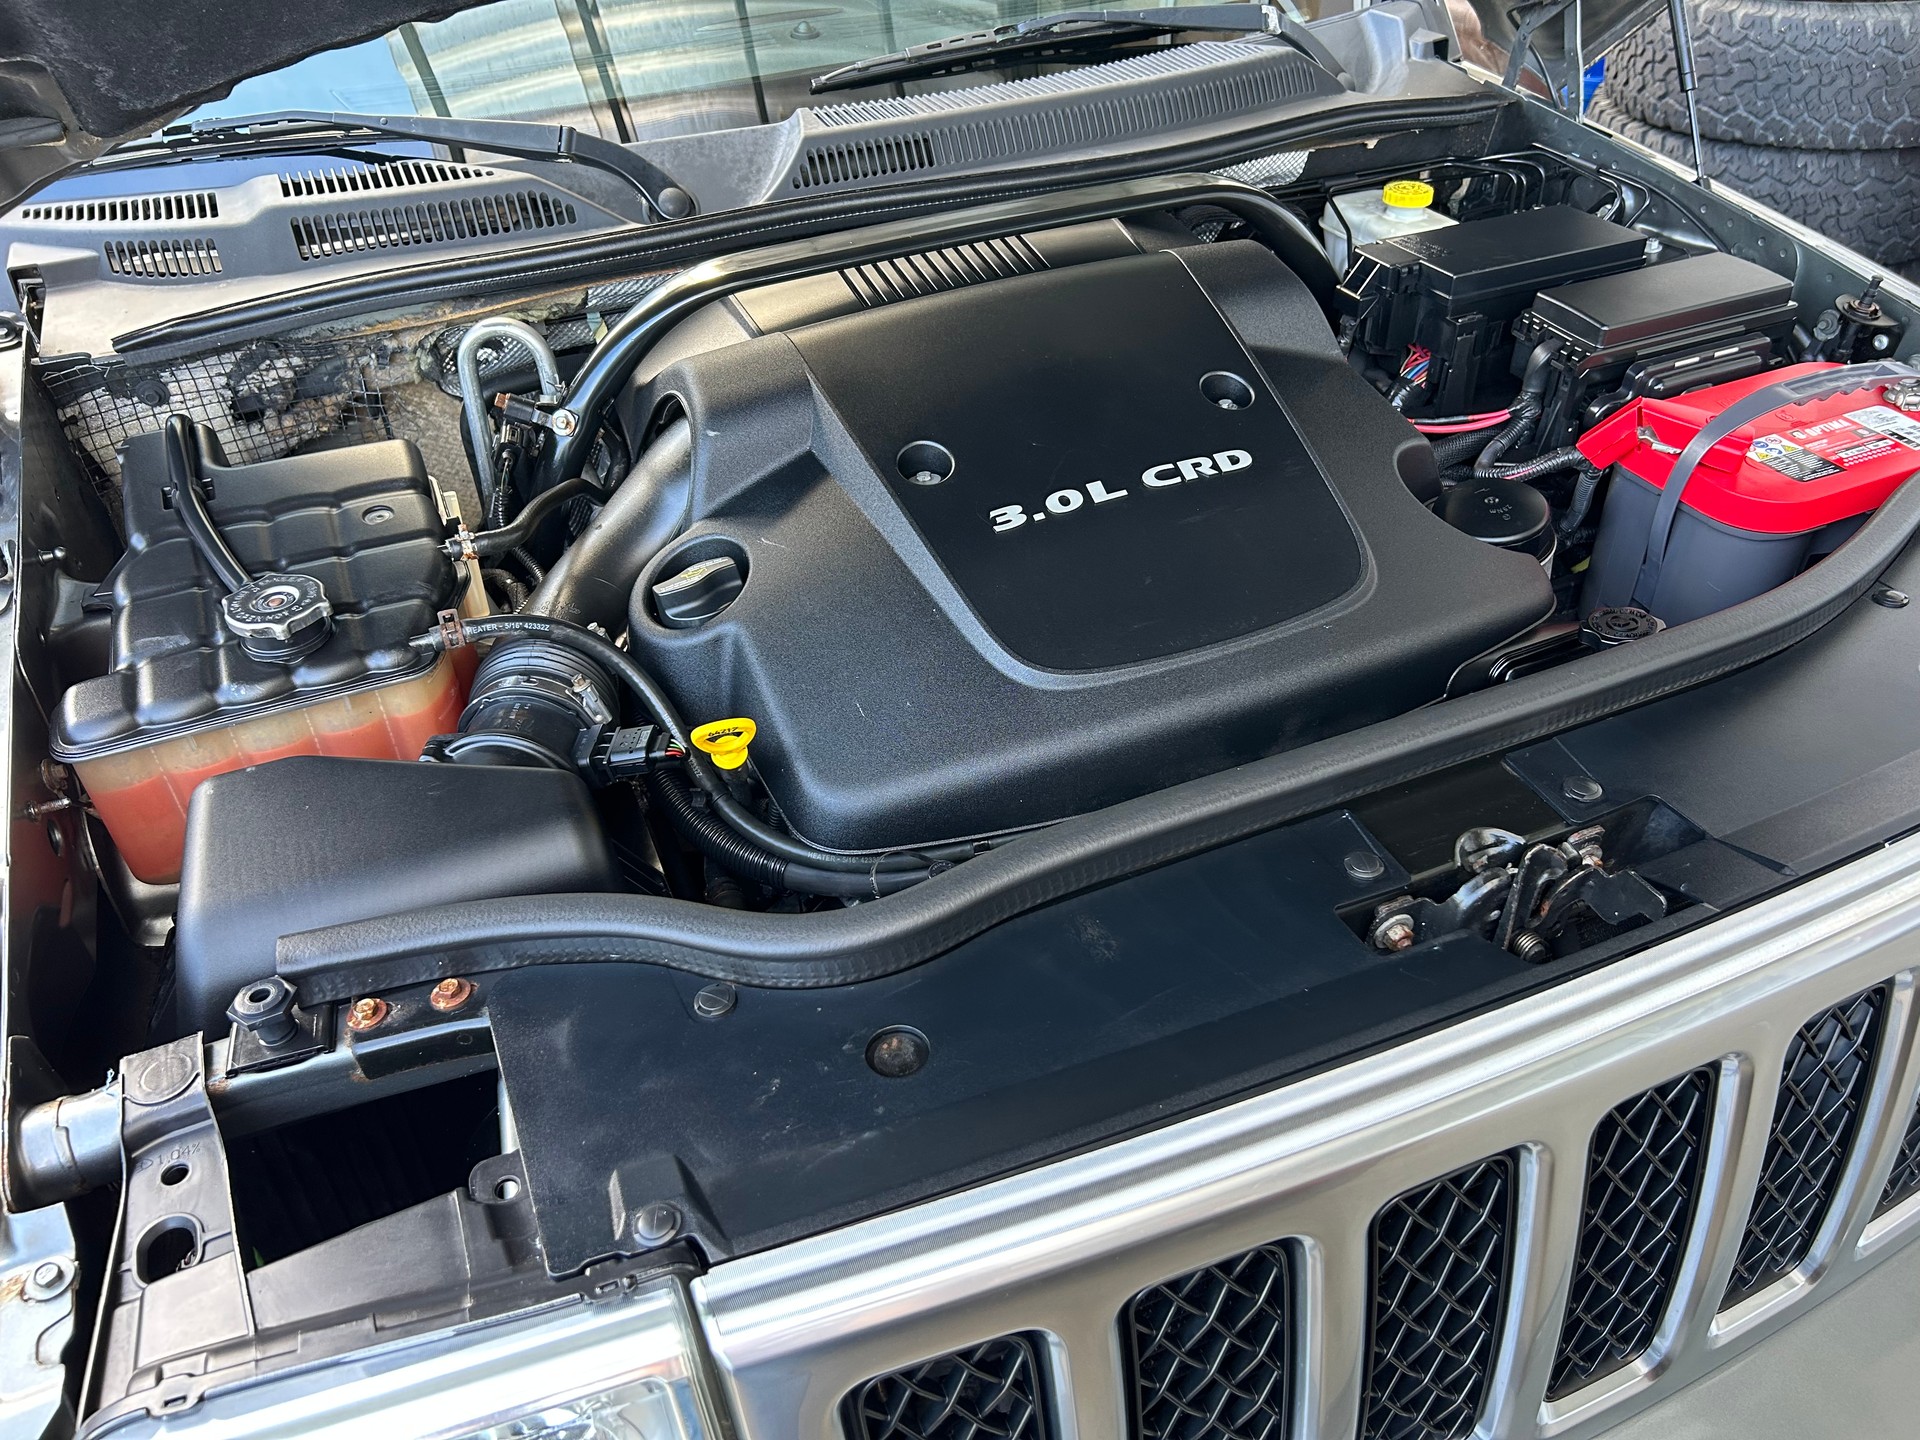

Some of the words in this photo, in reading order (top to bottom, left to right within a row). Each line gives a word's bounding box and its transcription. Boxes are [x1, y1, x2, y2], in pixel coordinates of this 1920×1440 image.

[1804, 418, 1852, 437] OPTIMA
[989, 480, 1128, 533] 3.0L
[1141, 449, 1253, 487] CRD
[466, 624, 498, 635] HEATER
[523, 623, 550, 632] 42332Z
[807, 852, 837, 863] HEATER
